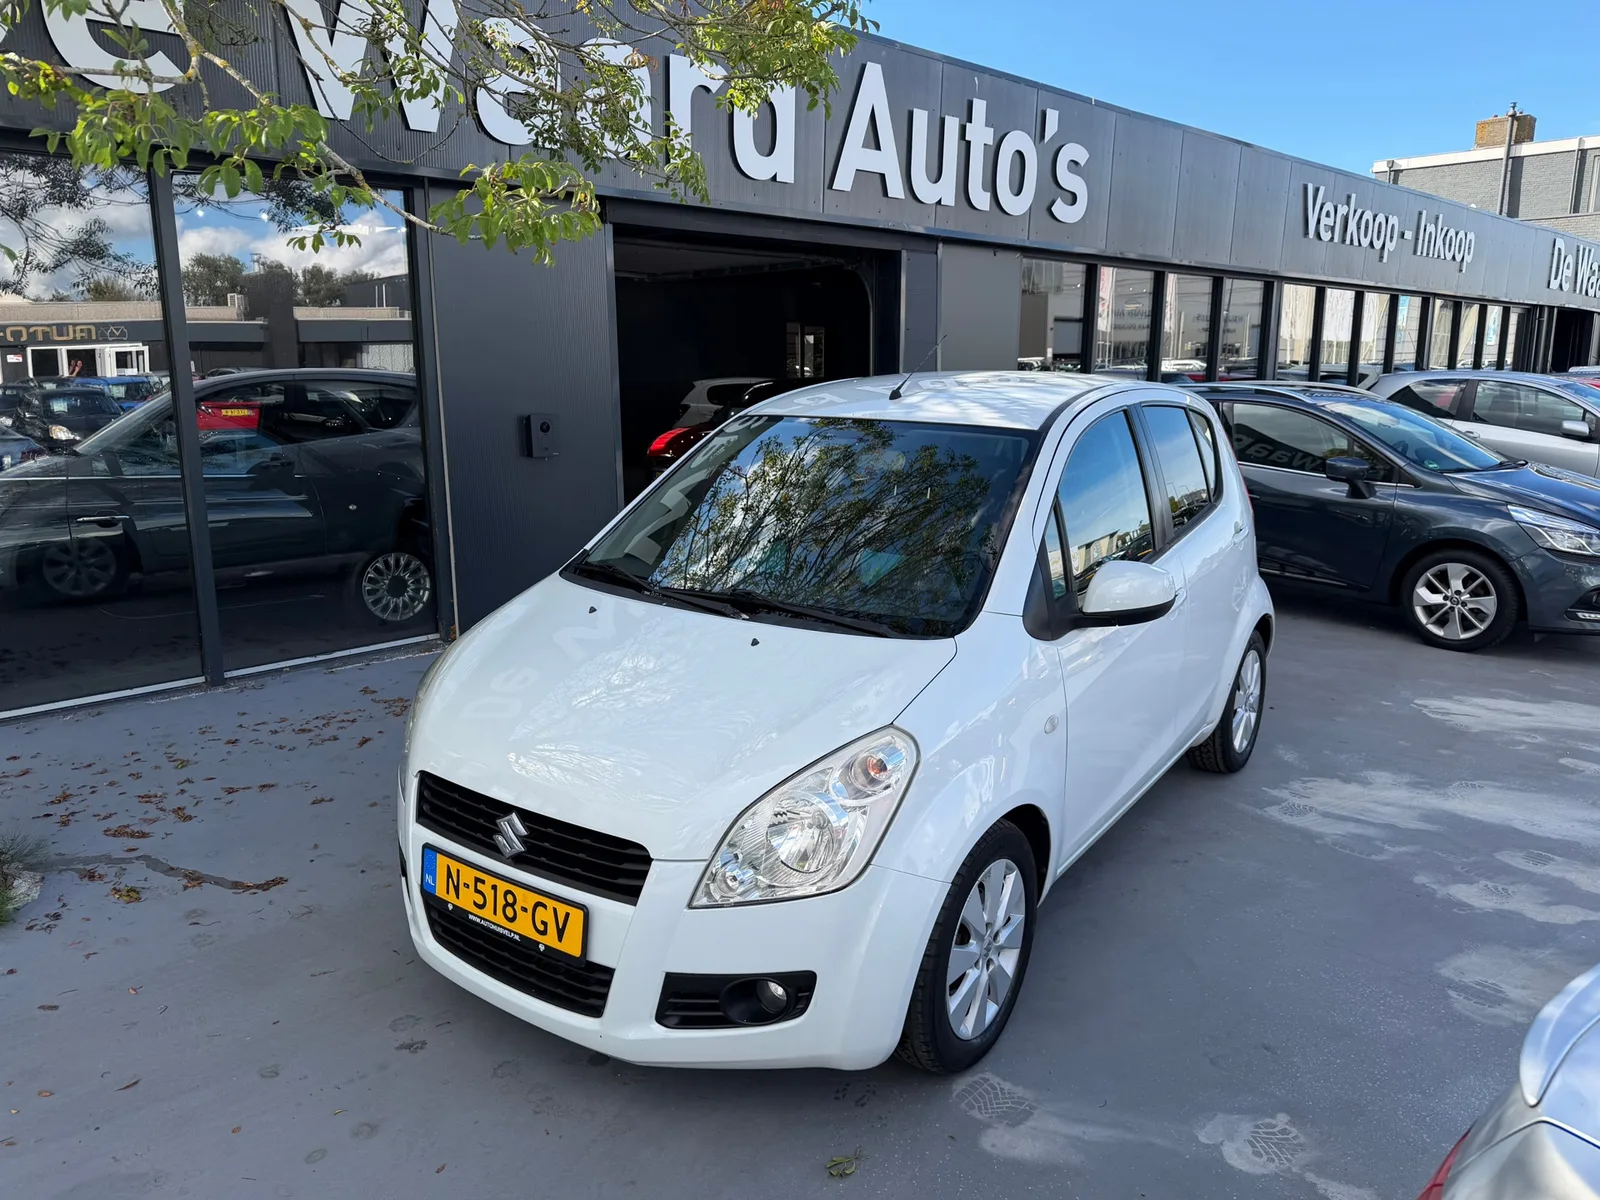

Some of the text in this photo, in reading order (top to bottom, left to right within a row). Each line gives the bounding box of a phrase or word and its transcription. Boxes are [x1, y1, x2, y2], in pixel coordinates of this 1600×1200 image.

[832, 61, 1090, 224] Auto's
[1306, 182, 1399, 263] Verkoop
[1416, 209, 1475, 273] Inkoop
[1549, 237, 1573, 292] De
[425, 872, 435, 887] NL
[446, 864, 570, 943] N-518-GV
